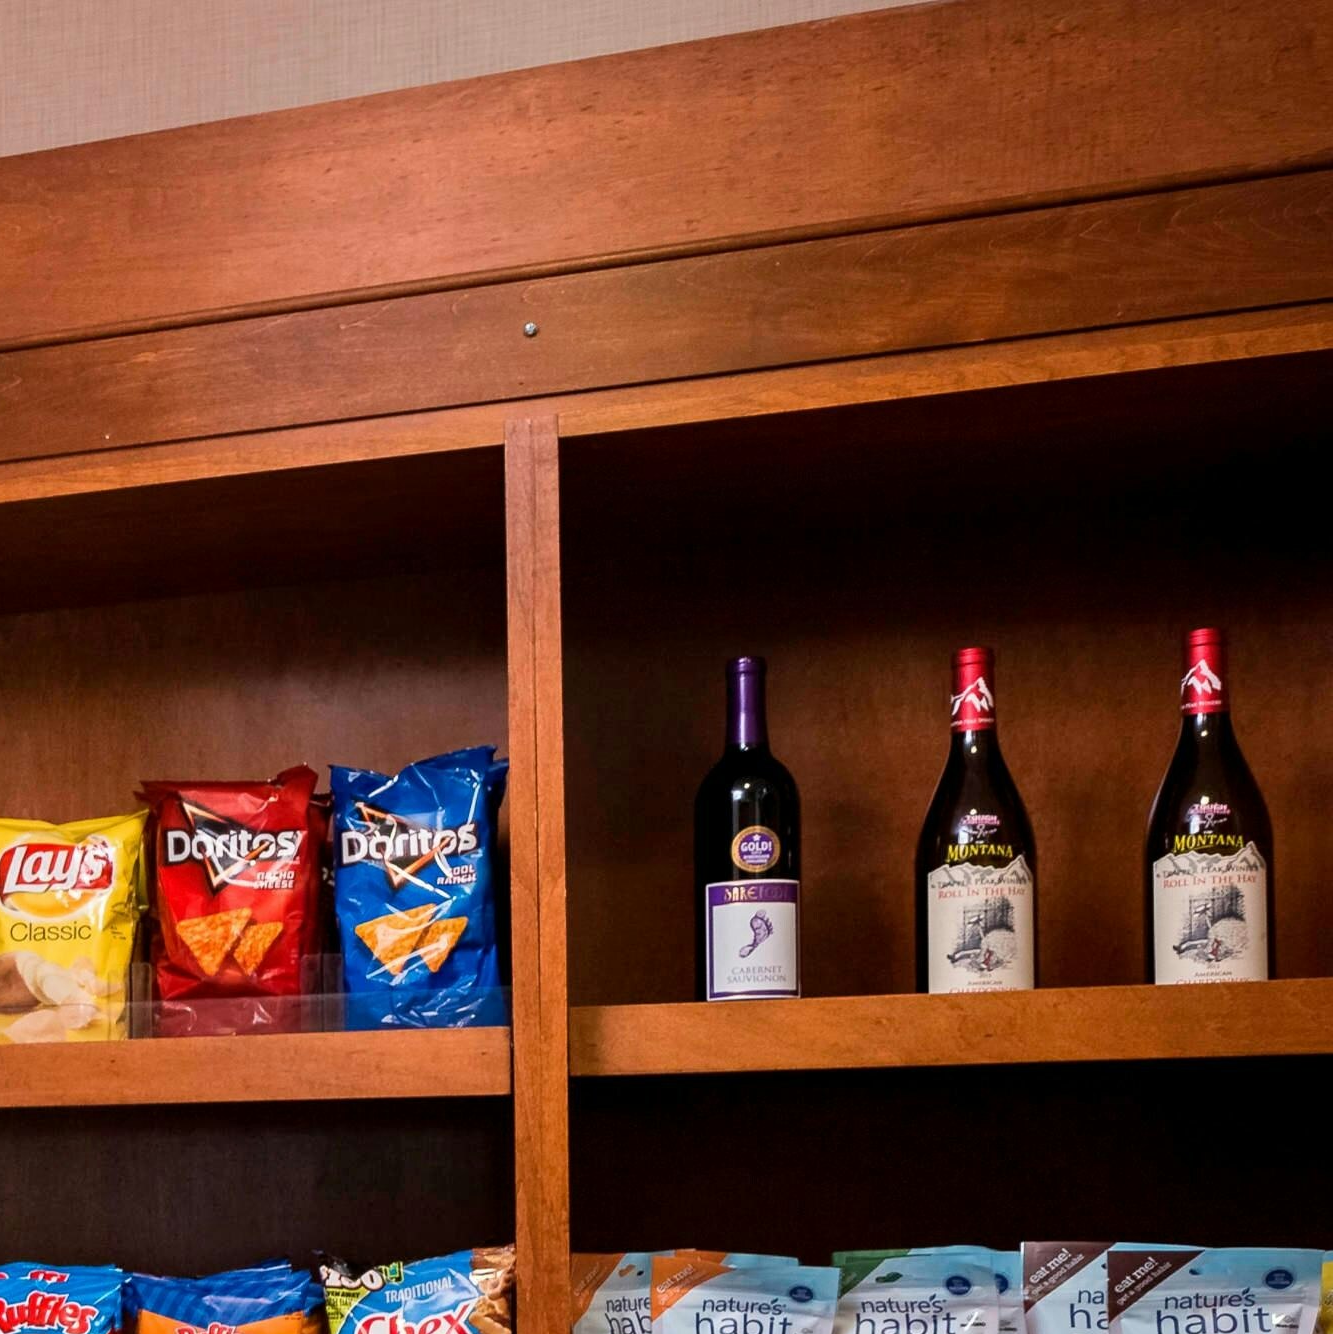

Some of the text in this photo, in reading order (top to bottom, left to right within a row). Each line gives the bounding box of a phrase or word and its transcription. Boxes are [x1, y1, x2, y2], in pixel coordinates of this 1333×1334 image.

[166, 829, 297, 864] Doritos
[341, 824, 478, 865] Doritos
[741, 841, 772, 851] GOLD!
[1173, 834, 1244, 853] MONTANA
[945, 844, 1013, 863] MONTANA
[2, 845, 105, 894] Lay's
[253, 879, 295, 889] CHEESE
[967, 886, 979, 896] IN
[983, 885, 1005, 896] THE
[1008, 886, 1026, 896] HAY
[10, 921, 92, 942] Classic
[727, 974, 786, 984] SAUVIGNON
[1113, 1256, 1157, 1295] eat me!
[385, 1277, 455, 1304] TRADITIONAL
[1164, 1289, 1255, 1309] nature's
[702, 1297, 783, 1316] nature's
